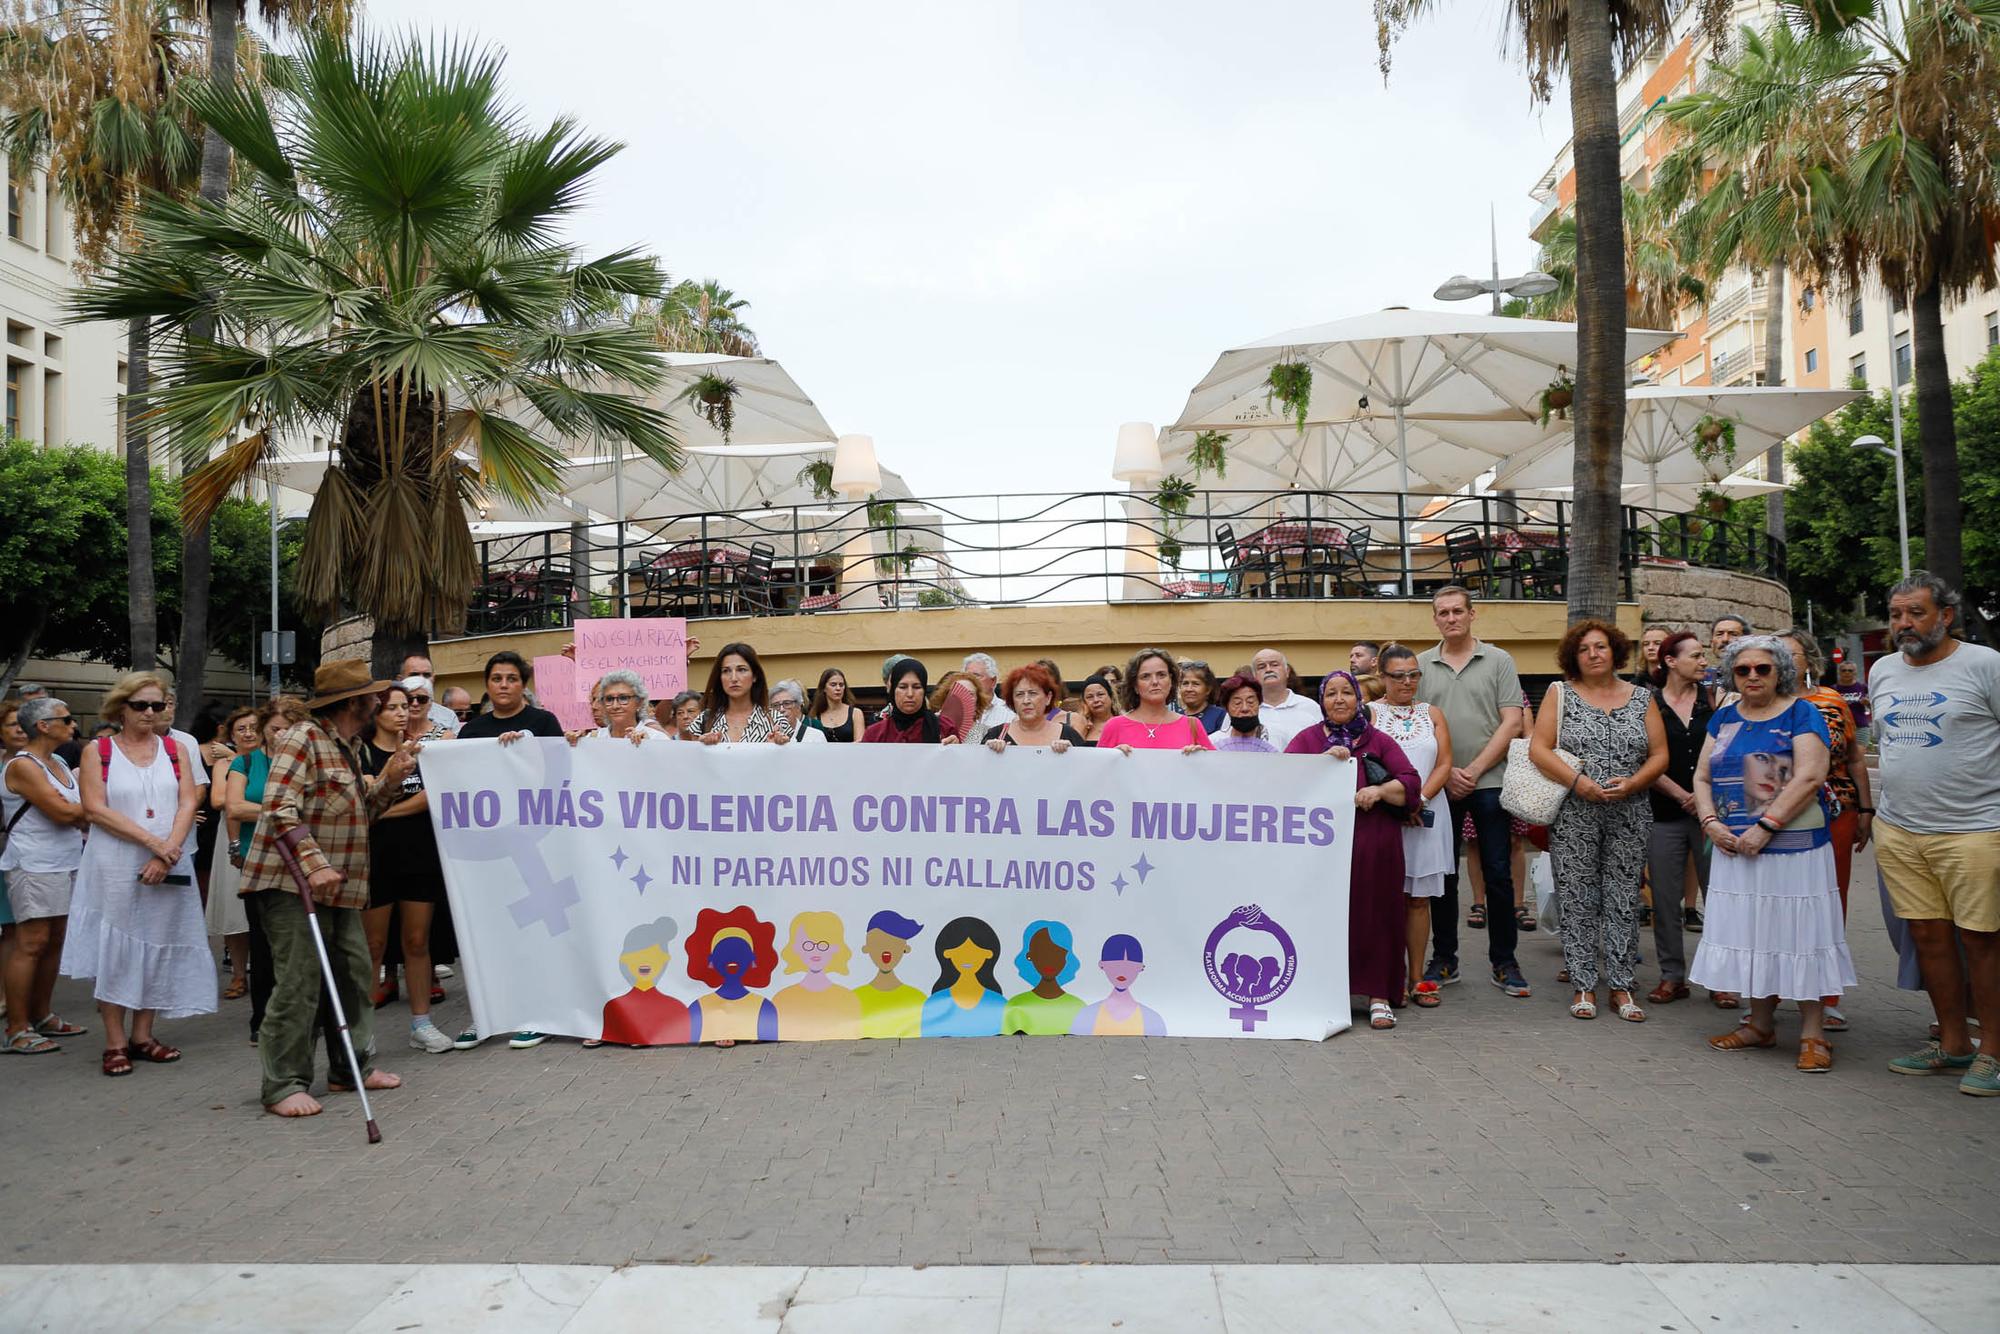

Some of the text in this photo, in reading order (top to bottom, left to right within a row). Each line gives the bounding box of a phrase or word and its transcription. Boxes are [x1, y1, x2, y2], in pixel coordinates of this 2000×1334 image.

[582, 628, 684, 650] NO ES LA RAZA
[580, 655, 676, 669] ES EL MACHISMO
[643, 673, 680, 690] MATA
[441, 780, 1336, 847] NO MÁS VIOLENCIA CONTRA LAS MUJERES
[672, 855, 1096, 891] NI PARAMOS NI CALLAMOS
[1205, 951, 1226, 994] PLATAFORMA
[1226, 990, 1252, 1003] ACCIÓN
[1253, 983, 1285, 1003] FEMINISTA
